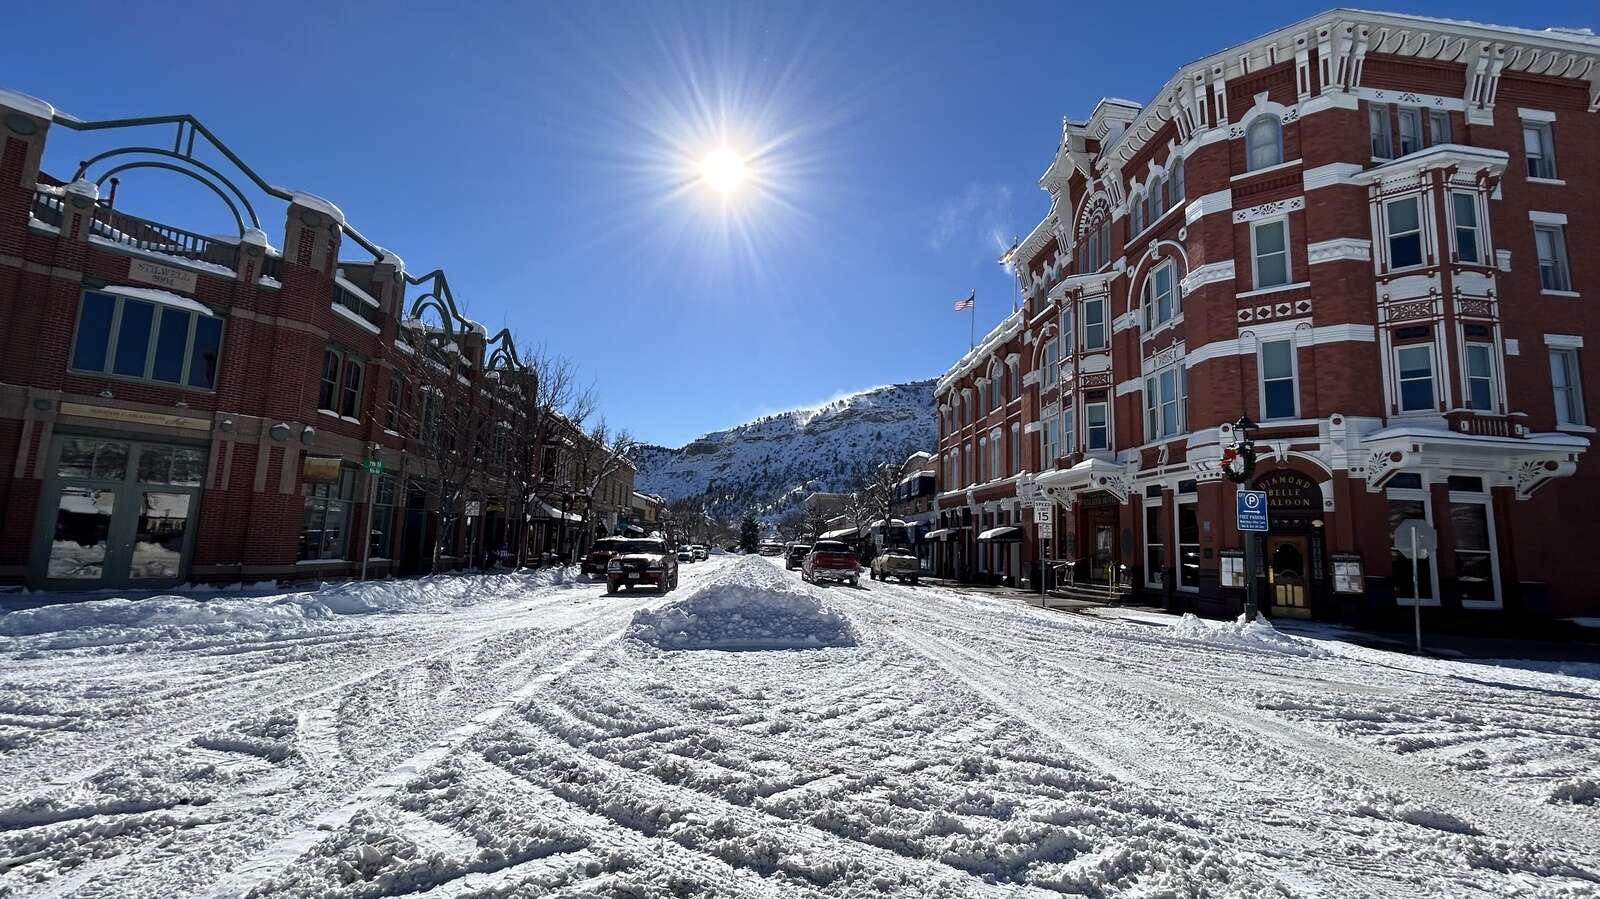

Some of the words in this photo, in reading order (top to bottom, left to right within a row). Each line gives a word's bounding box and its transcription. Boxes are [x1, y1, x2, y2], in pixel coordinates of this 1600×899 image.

[137, 263, 190, 281] STILWELL
[1259, 476, 1312, 489] DIAMOND
[1269, 498, 1311, 506] ALOON
[1038, 512, 1049, 521] 15
